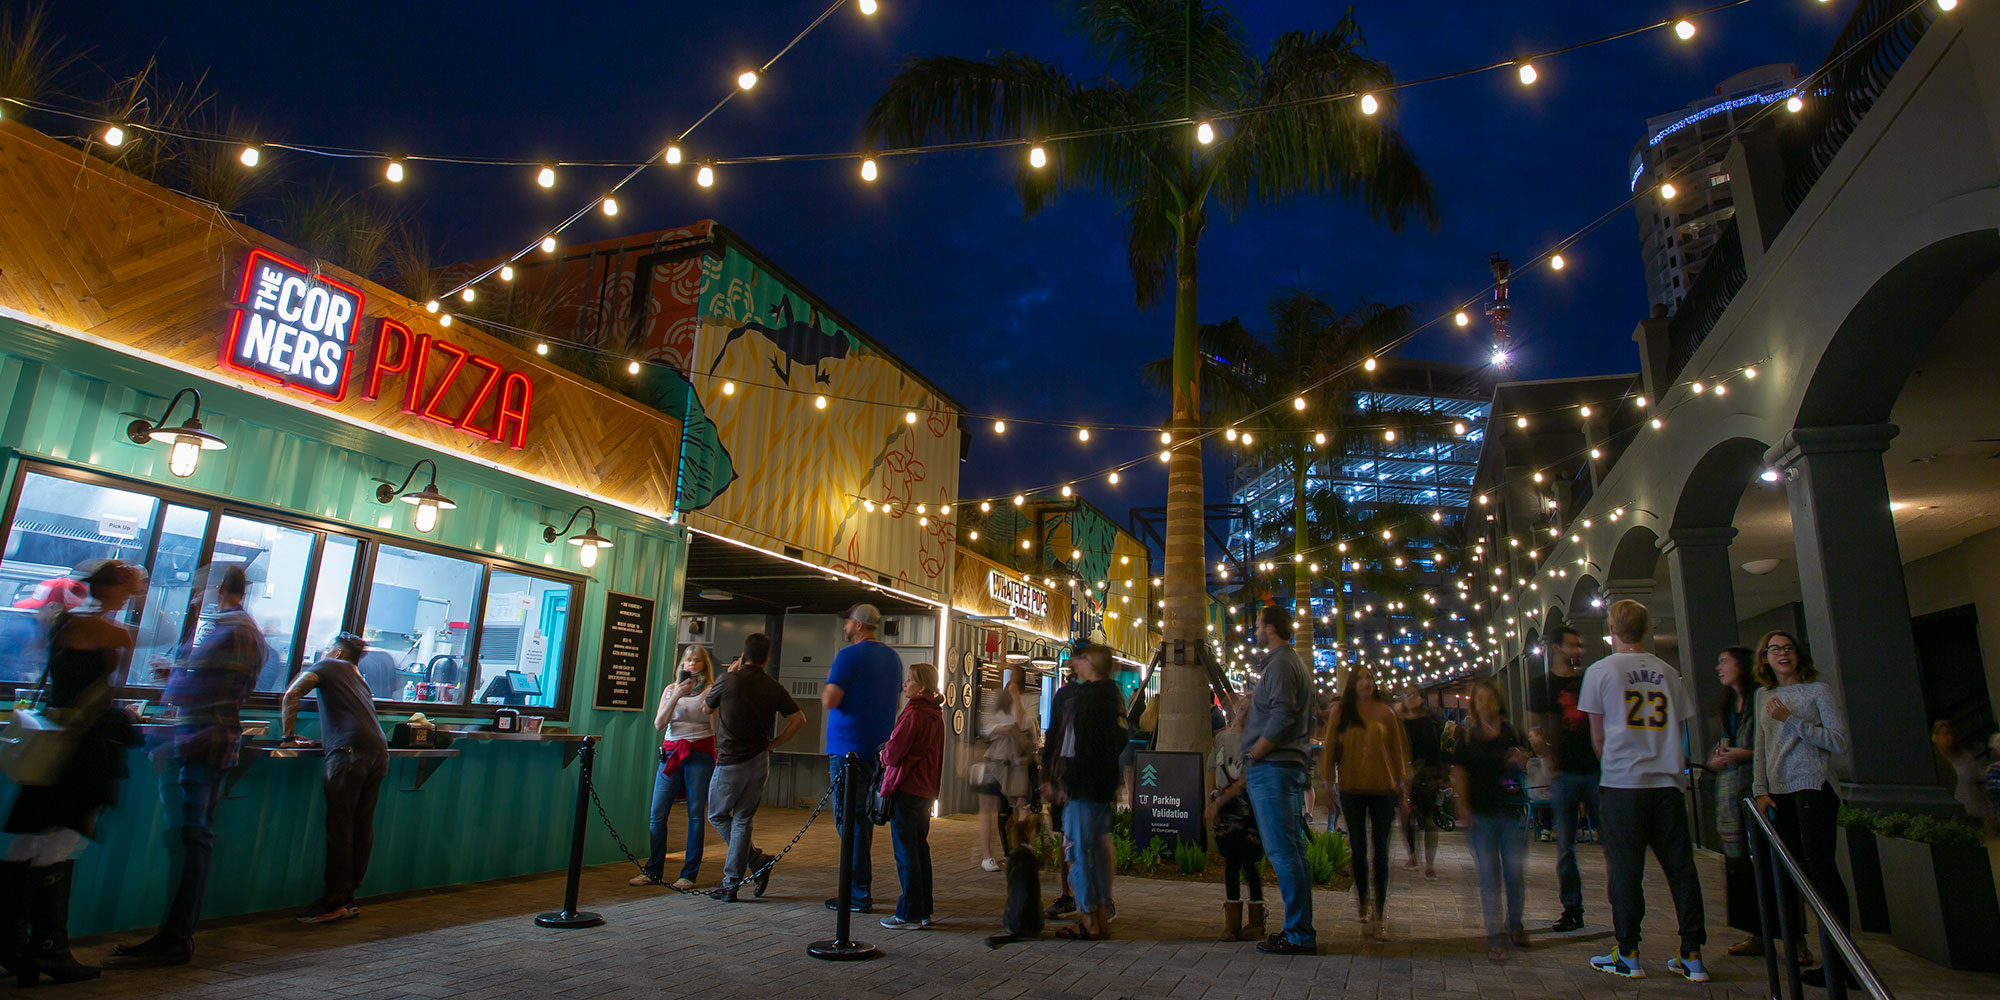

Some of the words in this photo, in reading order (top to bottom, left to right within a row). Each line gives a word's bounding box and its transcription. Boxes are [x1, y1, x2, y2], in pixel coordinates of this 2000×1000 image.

[254, 267, 283, 311] THE
[276, 277, 351, 341] COR
[243, 313, 342, 386] NERS
[361, 317, 533, 450] PIZZA
[991, 571, 1030, 607] WHATEVER
[1031, 588, 1049, 614] POPS
[1627, 670, 1664, 685] JAMES
[1624, 689, 1669, 731] 23
[1152, 795, 1180, 807] Parking
[1152, 808, 1188, 818] Validation
